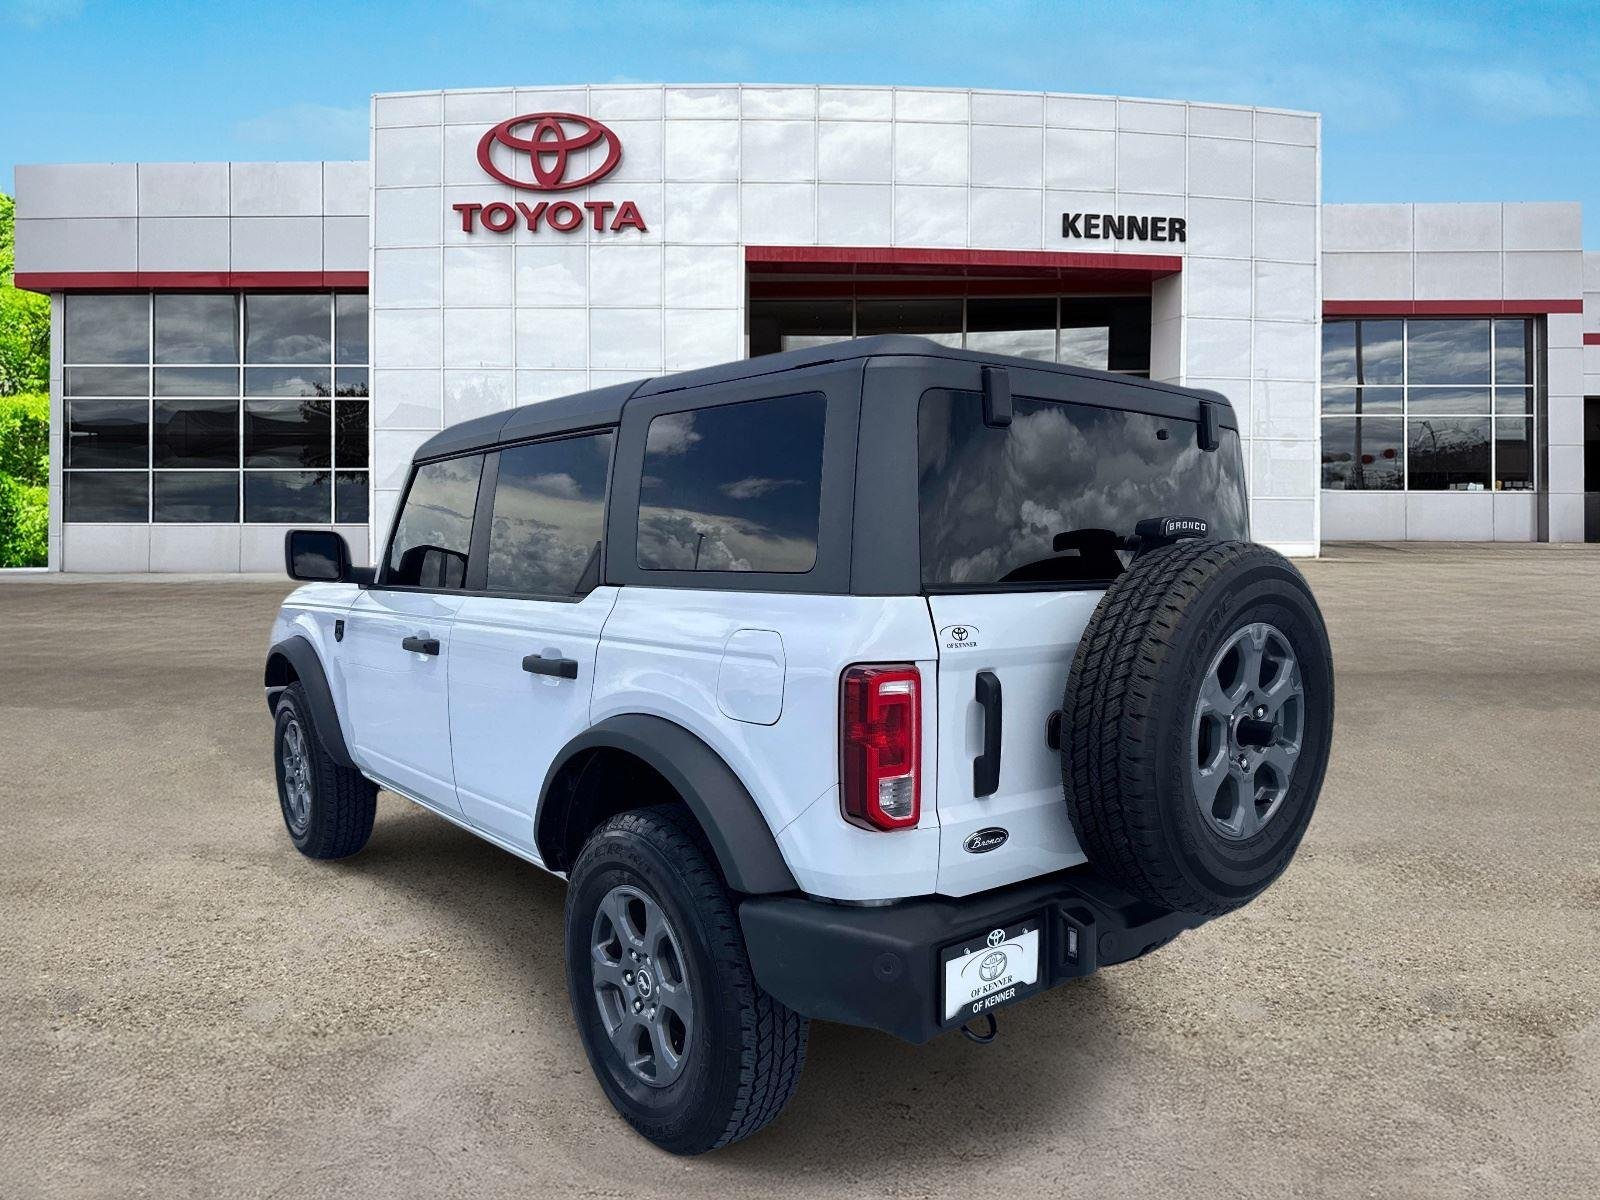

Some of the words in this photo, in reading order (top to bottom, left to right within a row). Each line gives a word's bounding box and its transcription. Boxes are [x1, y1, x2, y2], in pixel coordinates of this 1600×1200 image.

[453, 201, 646, 232] TOYOTA
[1062, 213, 1186, 242] KENNER
[1169, 521, 1206, 532] BRONCO
[971, 836, 1005, 849] Bronco
[971, 988, 982, 998] OF
[982, 975, 1013, 995] KENNER
[972, 1001, 983, 1013] OF
[984, 987, 1016, 1009] KENNER
